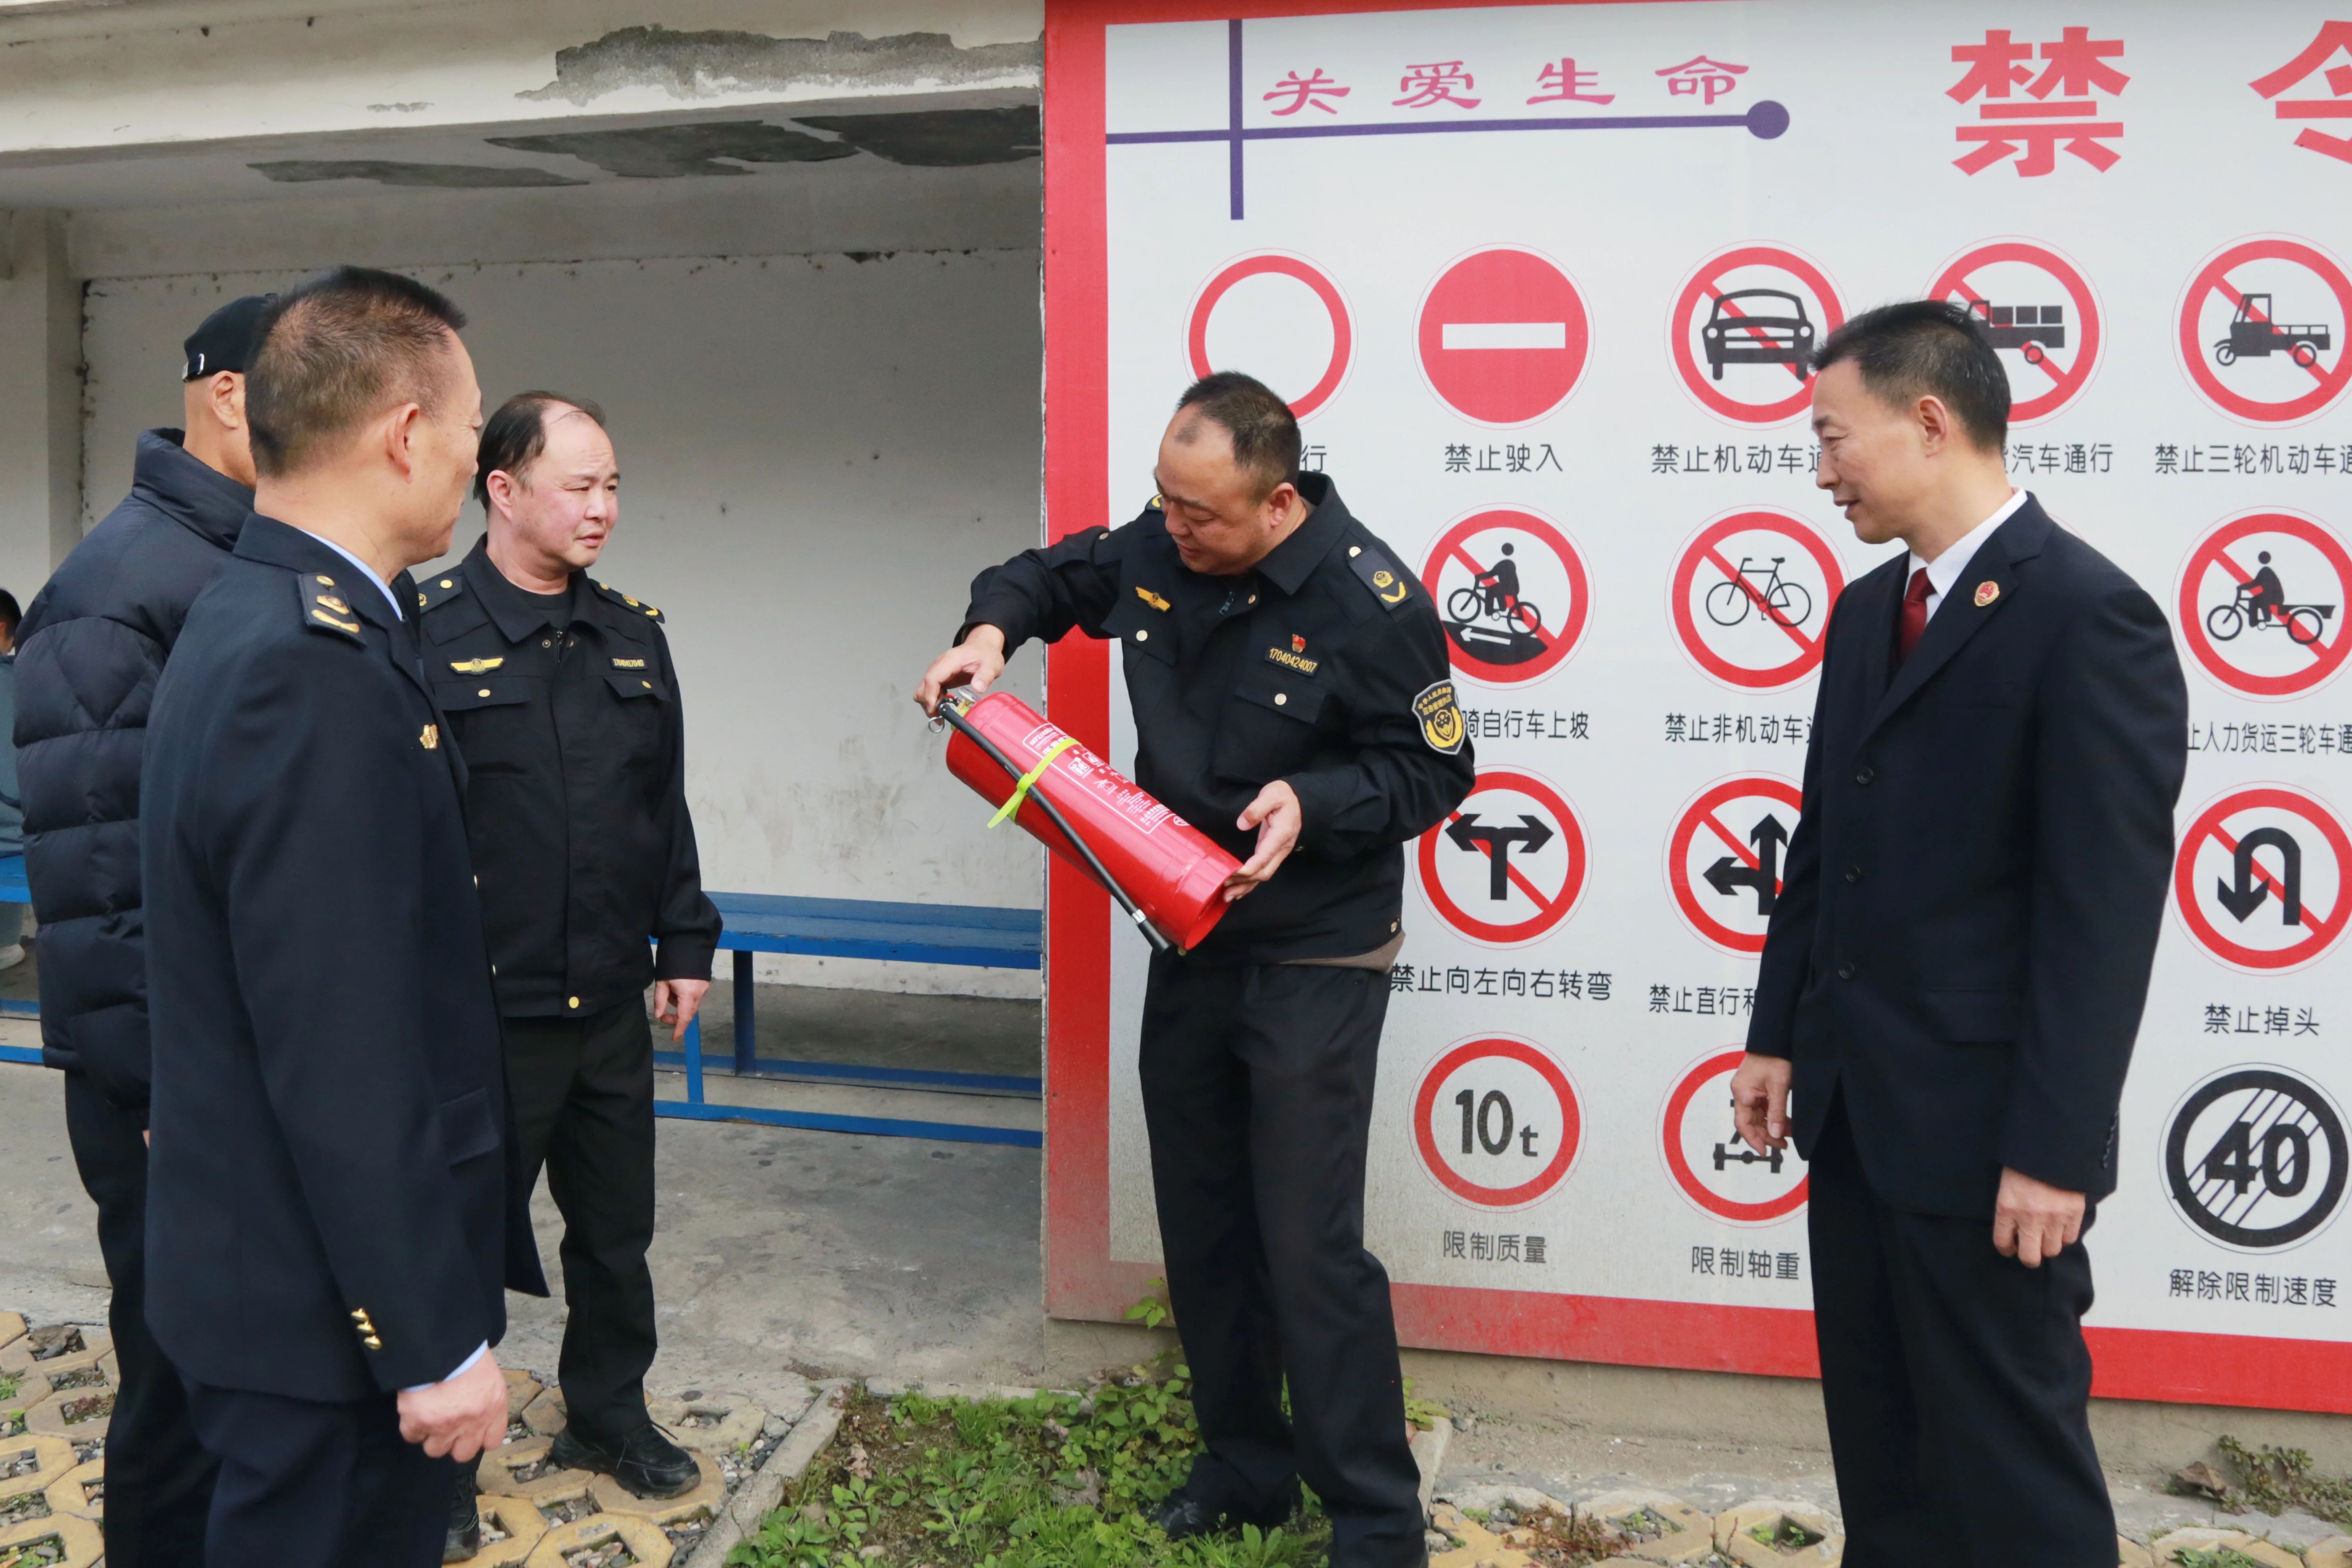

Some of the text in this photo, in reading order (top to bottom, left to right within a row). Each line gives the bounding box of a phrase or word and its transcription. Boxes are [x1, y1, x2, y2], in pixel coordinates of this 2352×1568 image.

[1263, 55, 1748, 116] 关爱生命
[1445, 443, 1563, 473] 禁止驶入
[2002, 443, 2113, 474] 汽车通行
[1665, 713, 1812, 745] 禁止非机动车
[1391, 962, 1612, 1001] 禁止向左向右转弯
[2204, 1003, 2320, 1036] 禁止掉头
[2205, 1121, 2310, 1198] 40
[1443, 1229, 1547, 1264] 限制质量
[1691, 1246, 1800, 1280] 限制轴重
[2169, 1269, 2337, 1307] 解除限制速度
